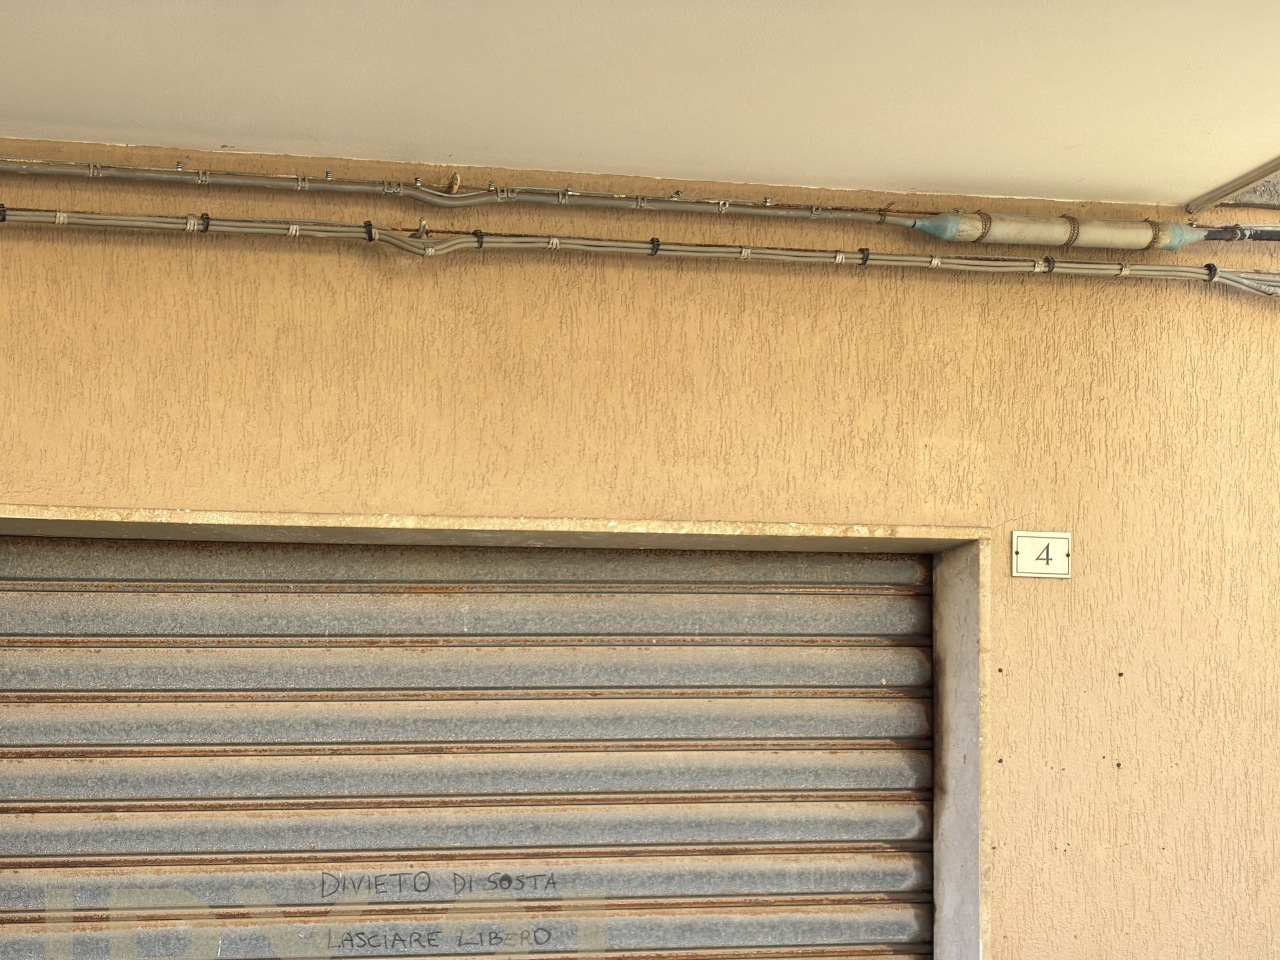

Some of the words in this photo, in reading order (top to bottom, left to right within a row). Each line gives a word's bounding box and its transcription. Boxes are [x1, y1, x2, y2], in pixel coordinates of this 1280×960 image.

[1034, 542, 1053, 566] 4
[321, 870, 432, 899] DIVIETO
[453, 872, 474, 895] DI
[487, 872, 558, 891] SOSTA
[326, 928, 444, 950] LASCIARE
[458, 928, 552, 948] LIBERO
